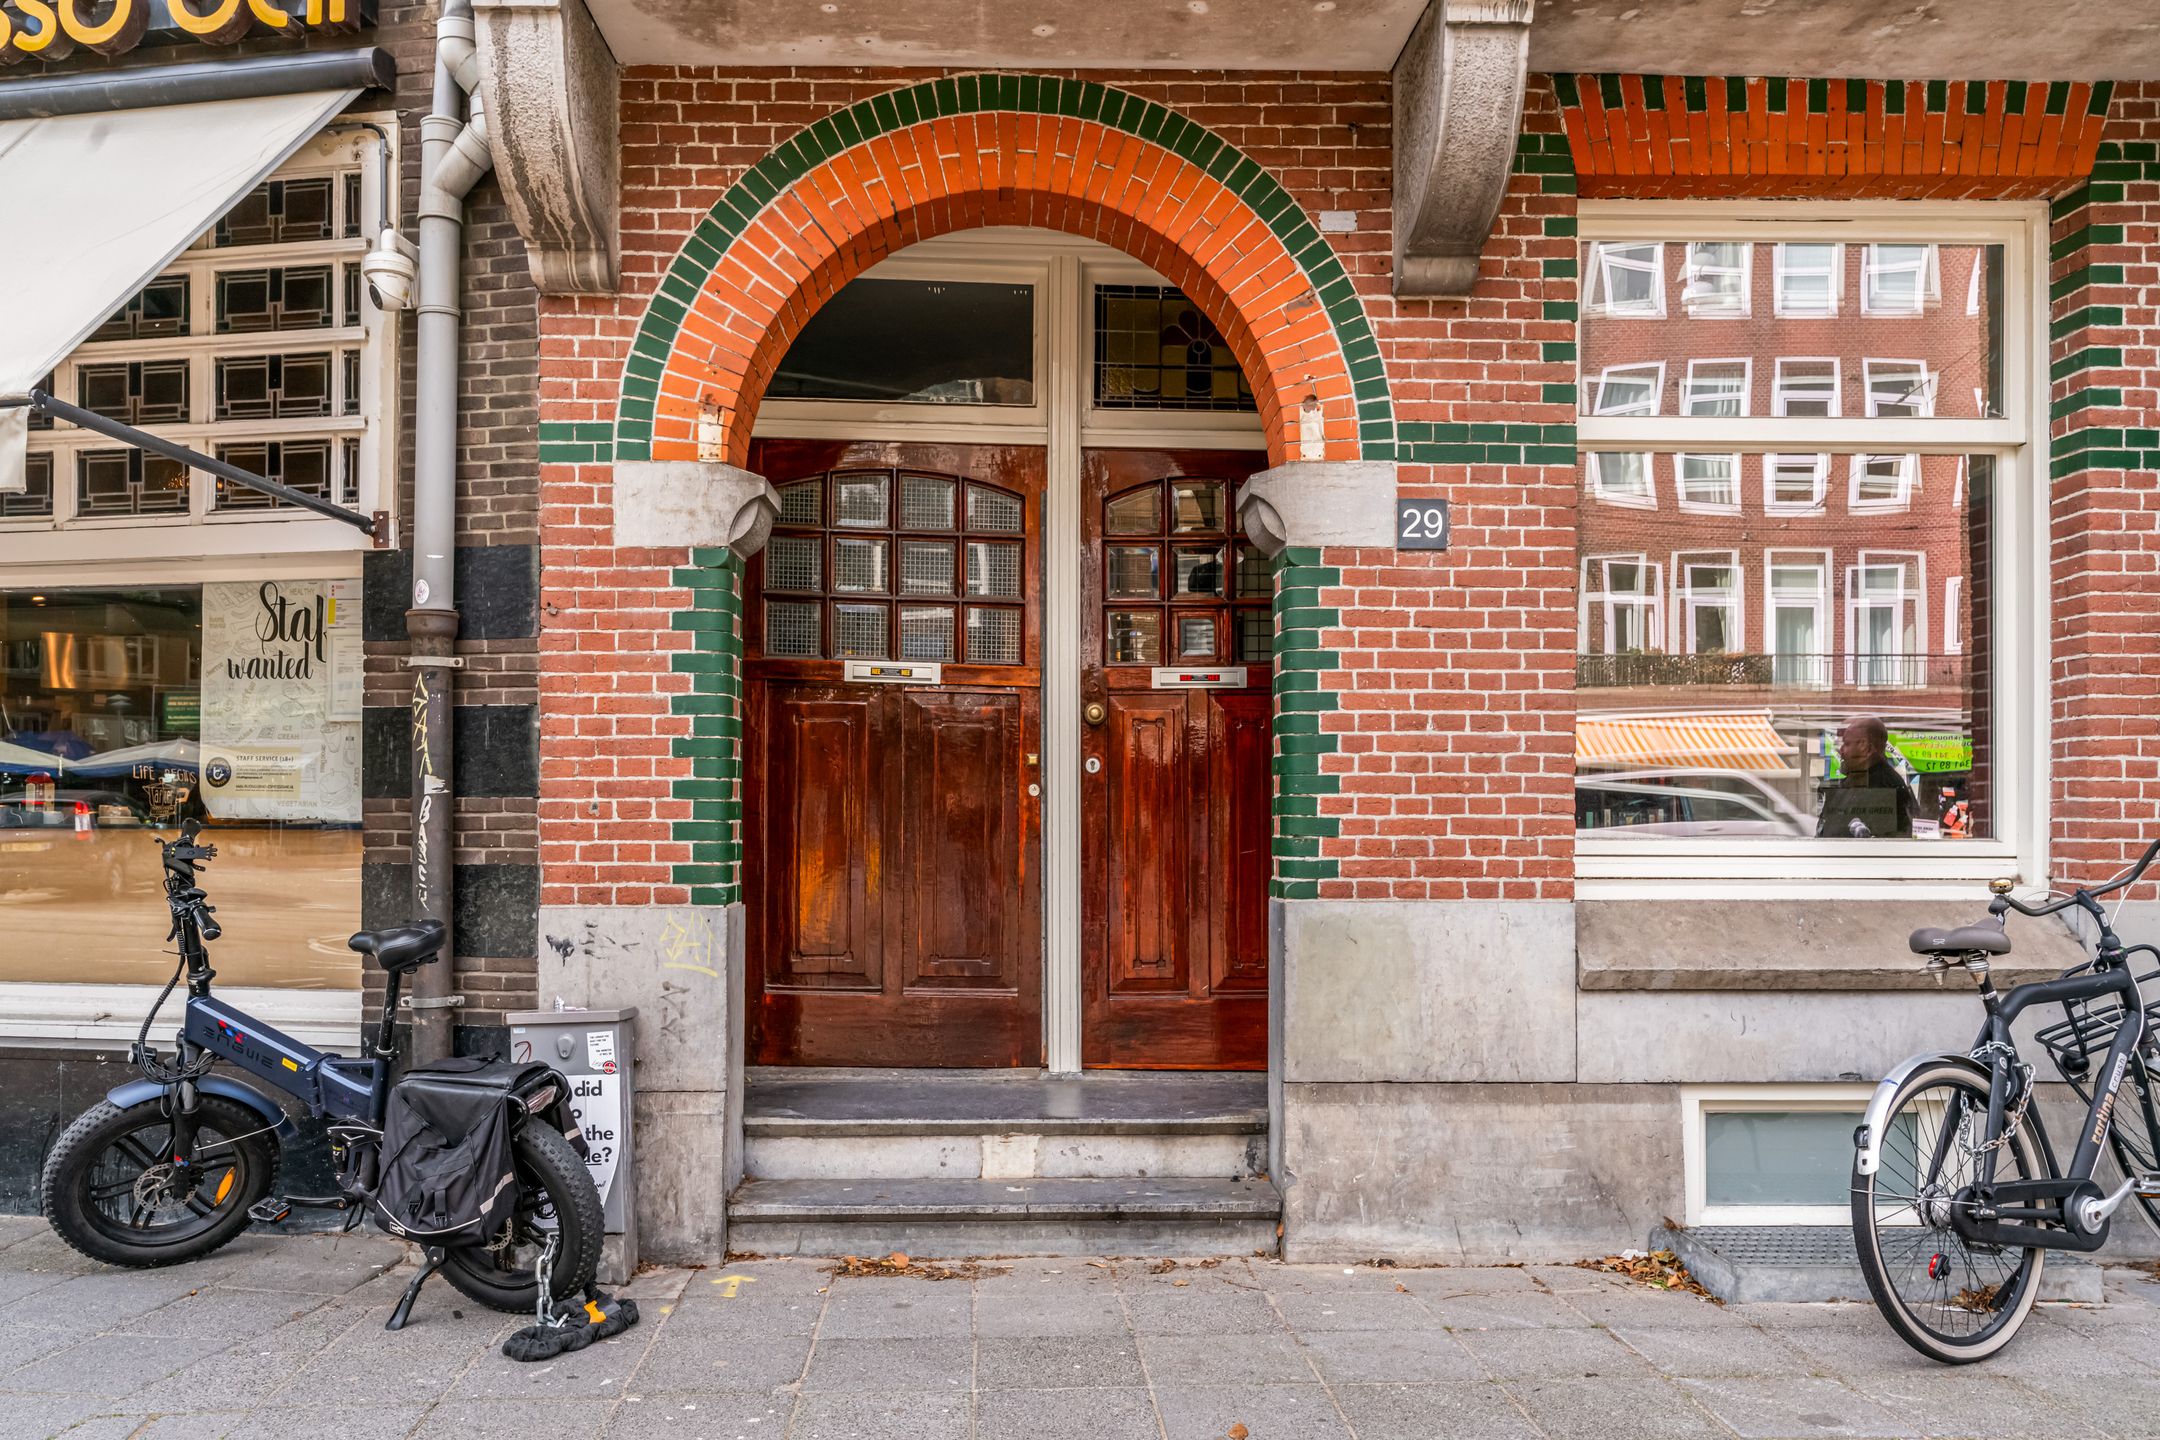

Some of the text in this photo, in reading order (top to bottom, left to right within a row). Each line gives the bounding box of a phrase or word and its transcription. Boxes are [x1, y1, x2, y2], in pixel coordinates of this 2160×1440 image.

[1402, 509, 1443, 538] 29
[227, 641, 314, 680] wanted
[574, 1080, 603, 1097] did
[585, 1124, 614, 1141] the
[2091, 1092, 2115, 1145] cortina
